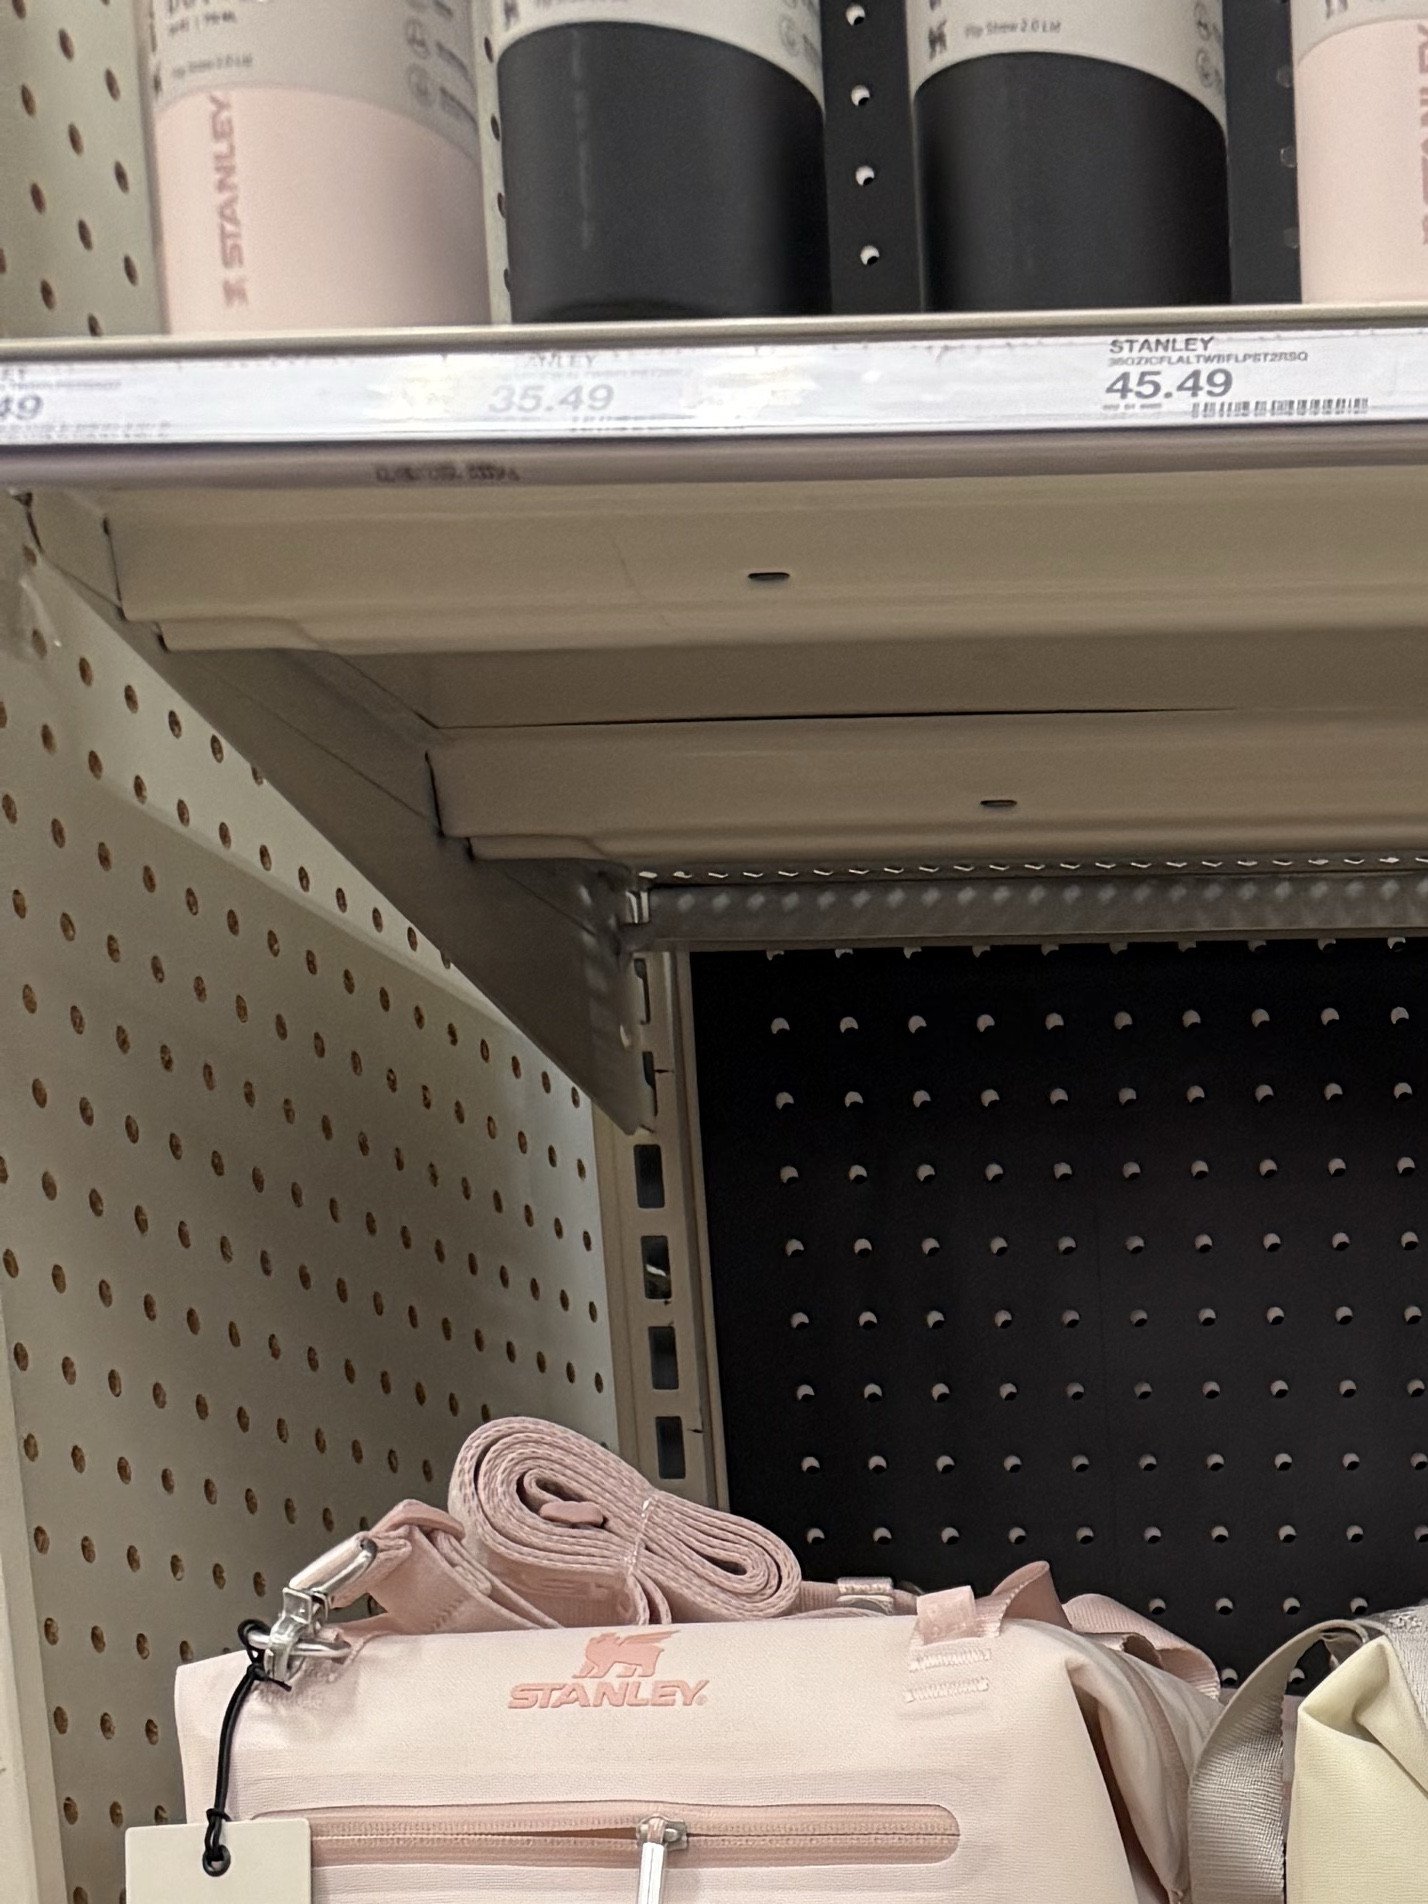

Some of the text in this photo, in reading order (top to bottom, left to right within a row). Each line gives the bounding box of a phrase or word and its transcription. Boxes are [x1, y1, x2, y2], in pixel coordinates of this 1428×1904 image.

[210, 94, 247, 274] STANLEY
[1109, 337, 1215, 354] STANLEY
[488, 383, 615, 413] 35.49
[1105, 368, 1233, 399] 45.49
[507, 1680, 710, 1709] STANLEY
